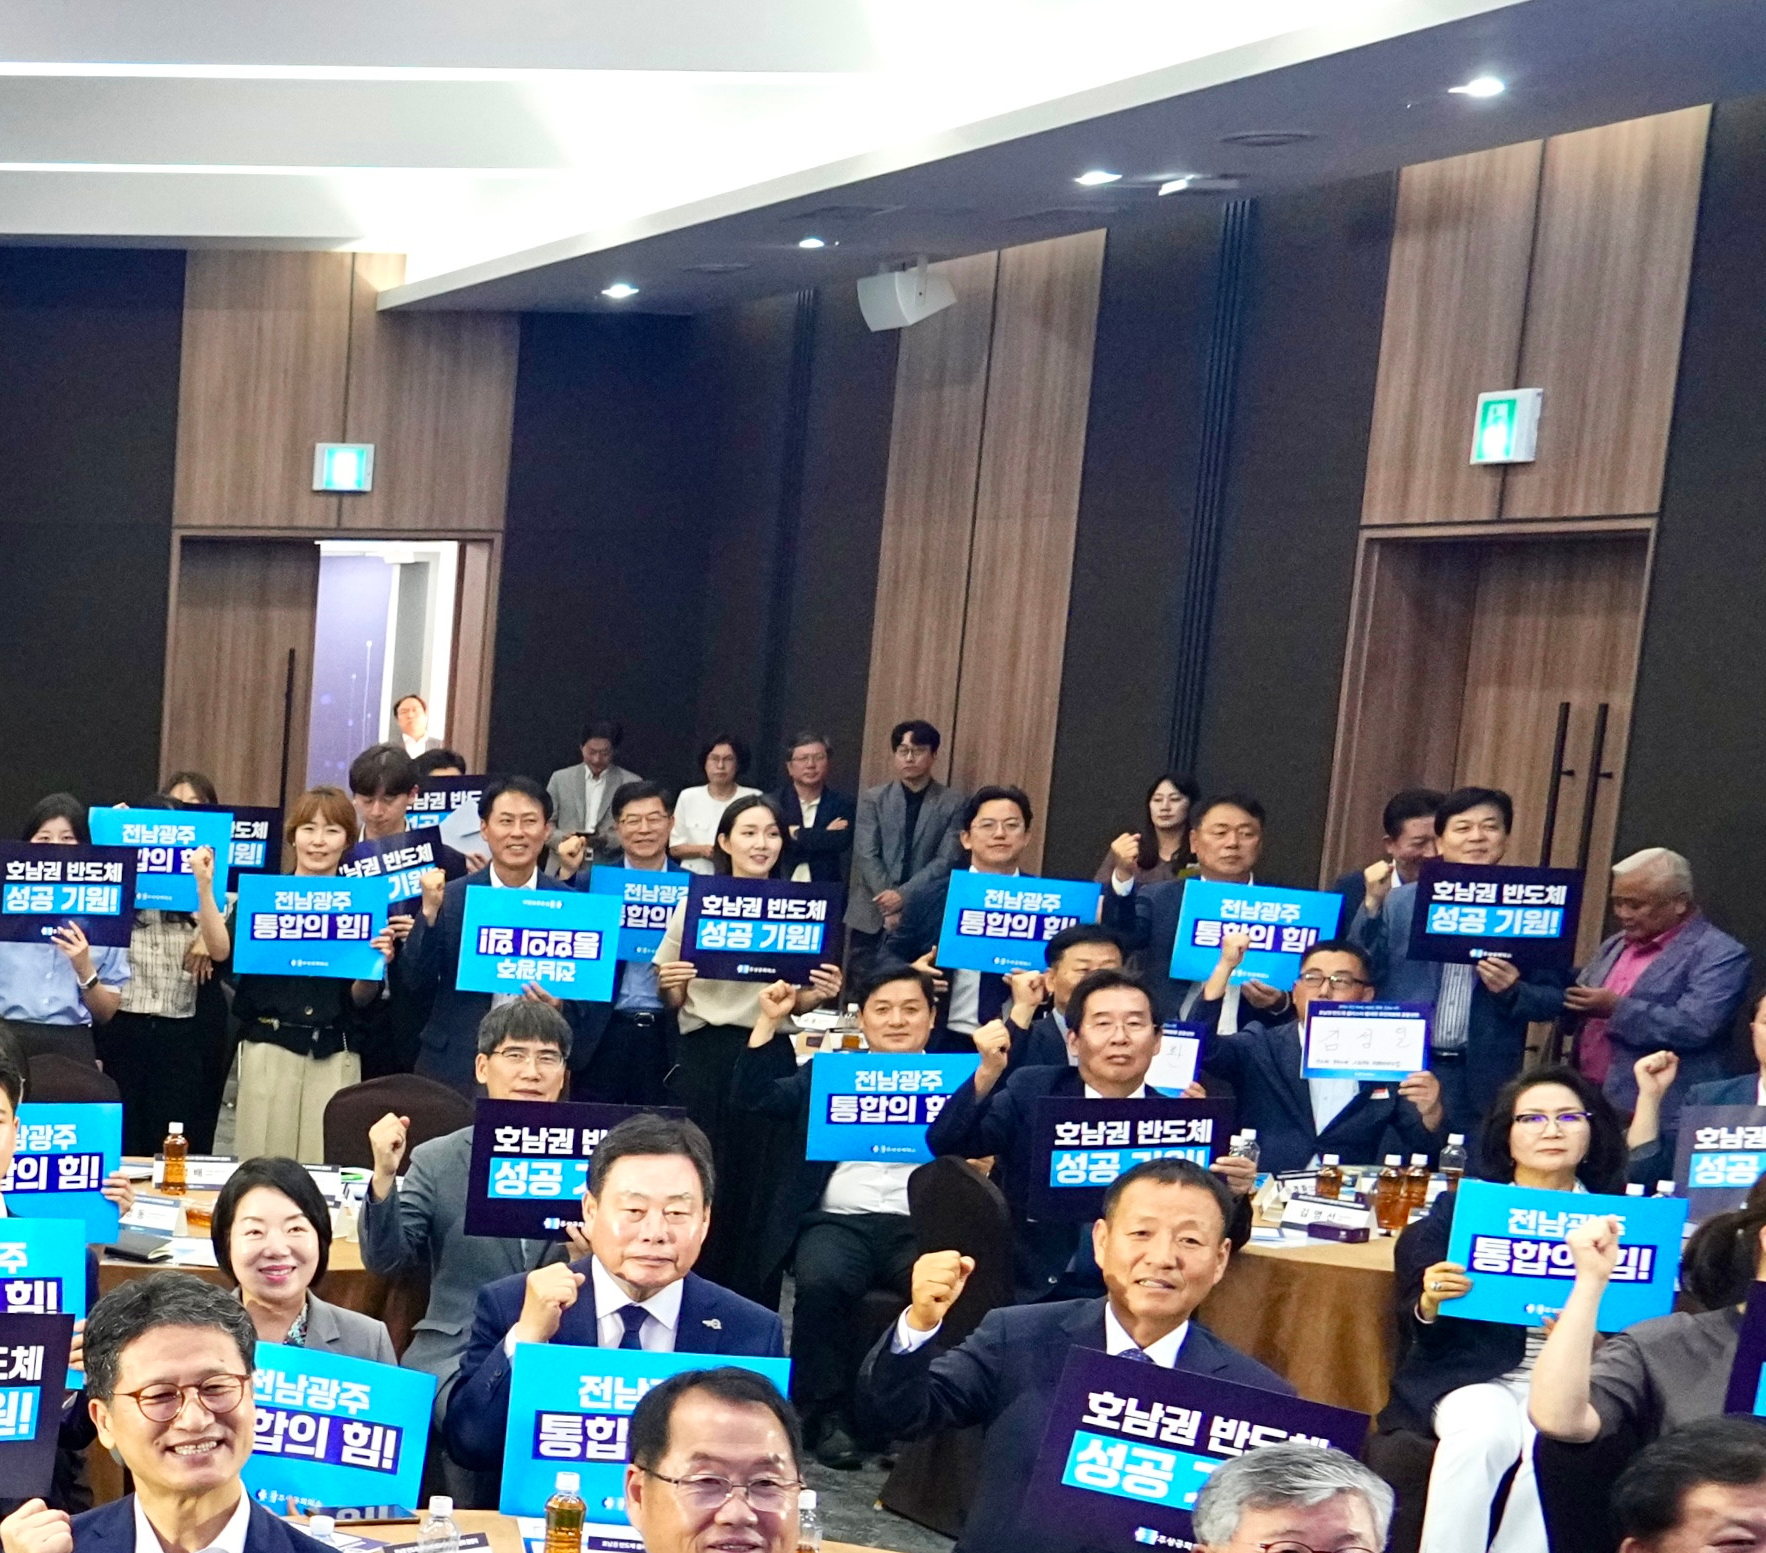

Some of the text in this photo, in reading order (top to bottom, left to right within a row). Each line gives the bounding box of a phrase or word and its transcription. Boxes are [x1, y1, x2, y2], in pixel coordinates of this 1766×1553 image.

[6, 861, 122, 882] 호남권 반도체
[7, 887, 117, 912] 성공 기원!
[276, 892, 351, 910] 전남광주
[1432, 881, 1567, 905] 호남권 반도체
[701, 895, 827, 920] 호남권 반도체
[254, 914, 369, 938] 통합의 힘!
[1432, 907, 1559, 935] 성공 기원!
[702, 922, 820, 950] 성공 기원!
